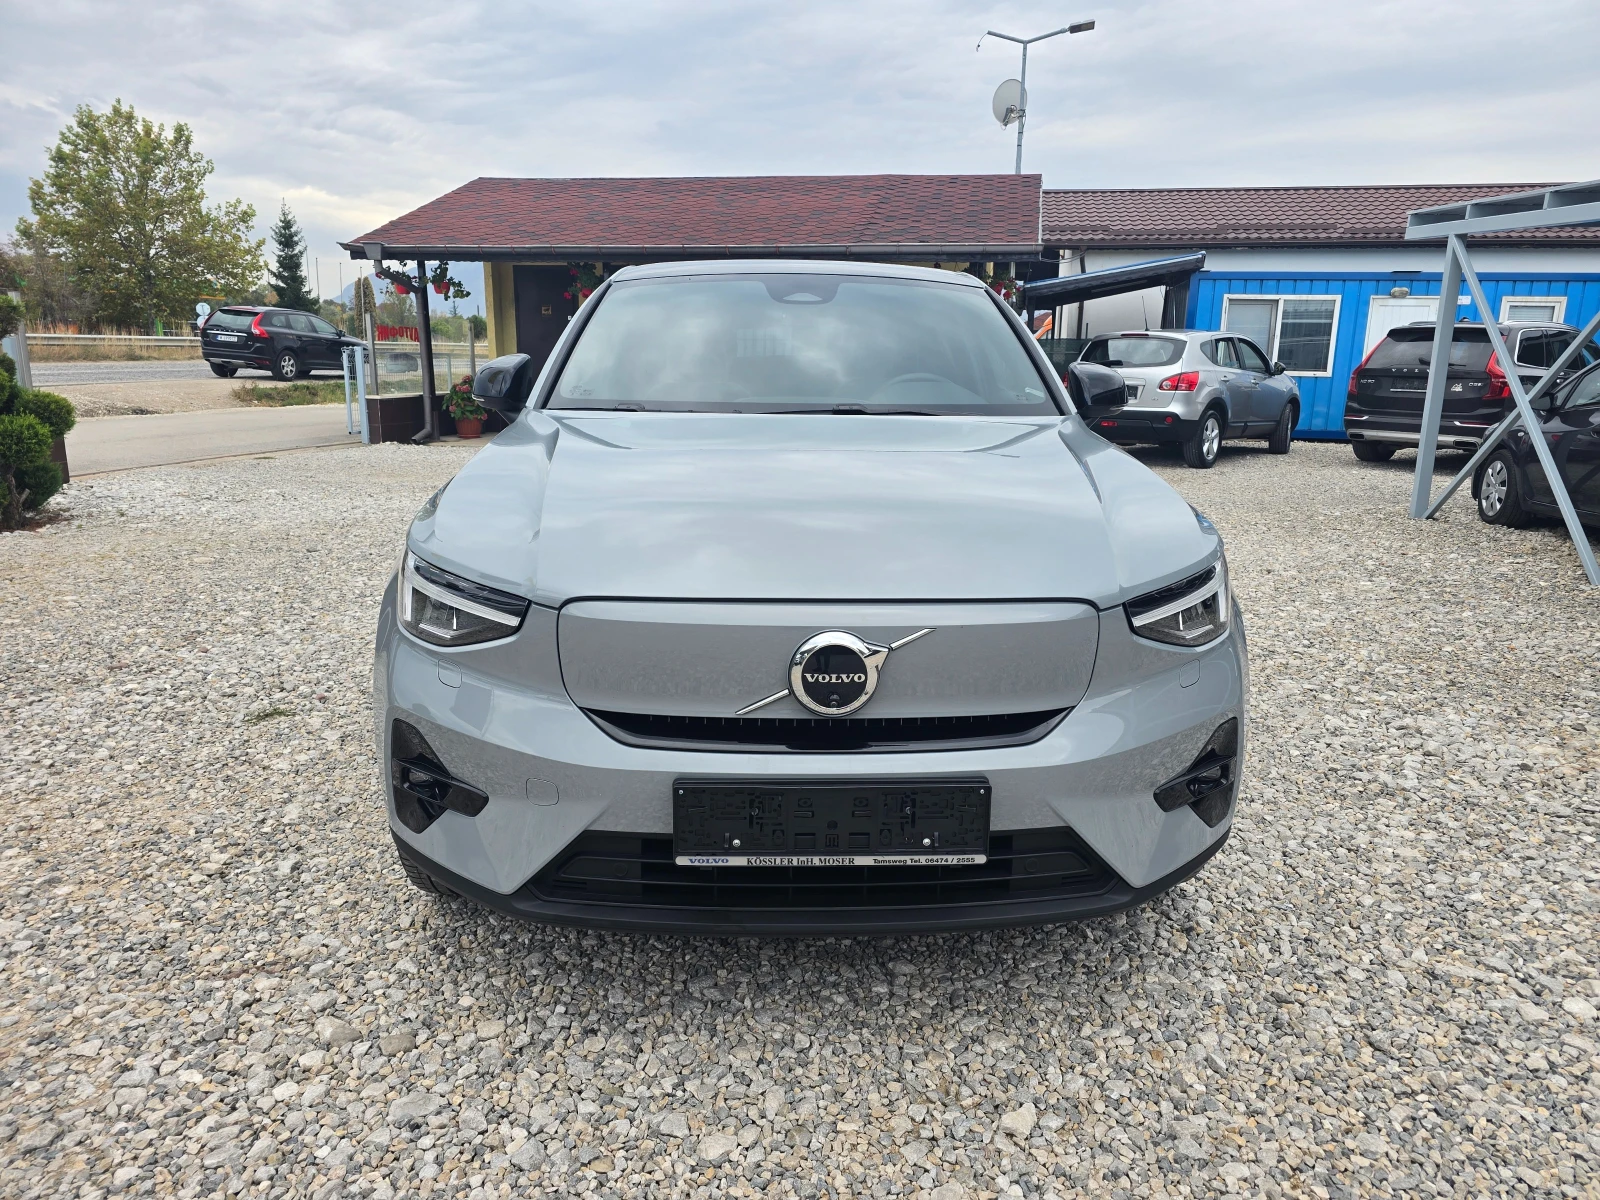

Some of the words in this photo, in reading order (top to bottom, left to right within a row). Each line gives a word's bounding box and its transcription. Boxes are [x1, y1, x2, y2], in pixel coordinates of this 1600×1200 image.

[803, 673, 866, 683] VOLVO
[746, 857, 794, 865] KÖSSLER
[818, 857, 856, 865] MOSER
